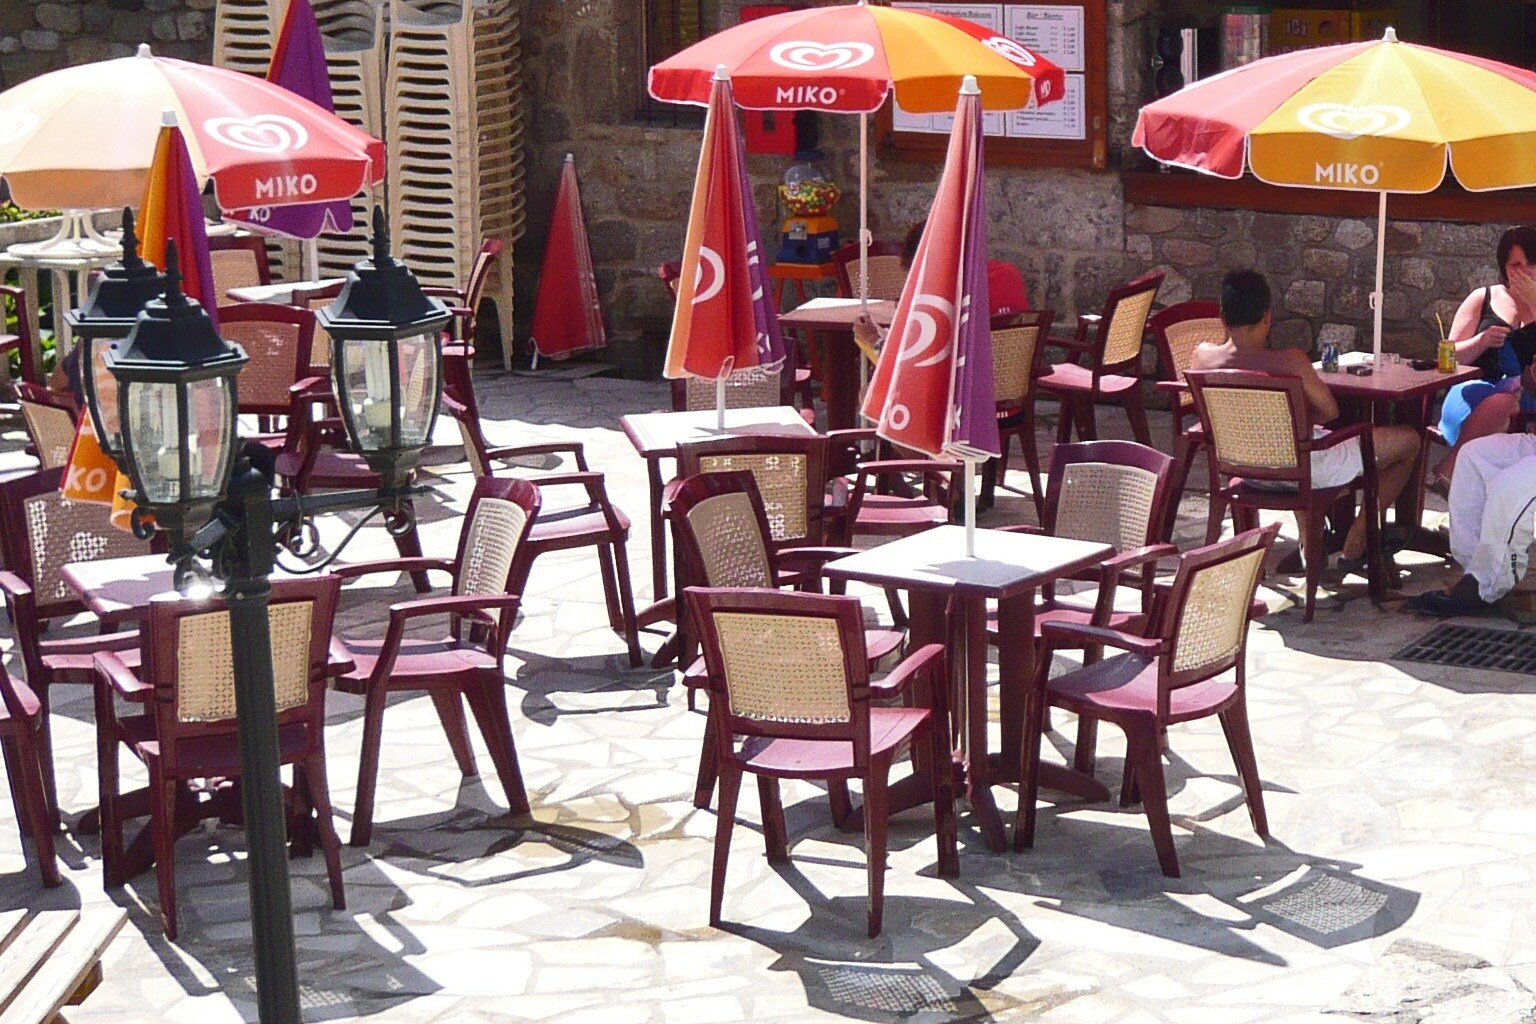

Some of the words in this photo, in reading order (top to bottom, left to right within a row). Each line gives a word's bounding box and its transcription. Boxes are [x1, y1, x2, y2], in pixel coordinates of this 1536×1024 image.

[776, 86, 839, 104] MIKO
[1315, 162, 1380, 185] MIKO
[255, 173, 317, 199] MIKO
